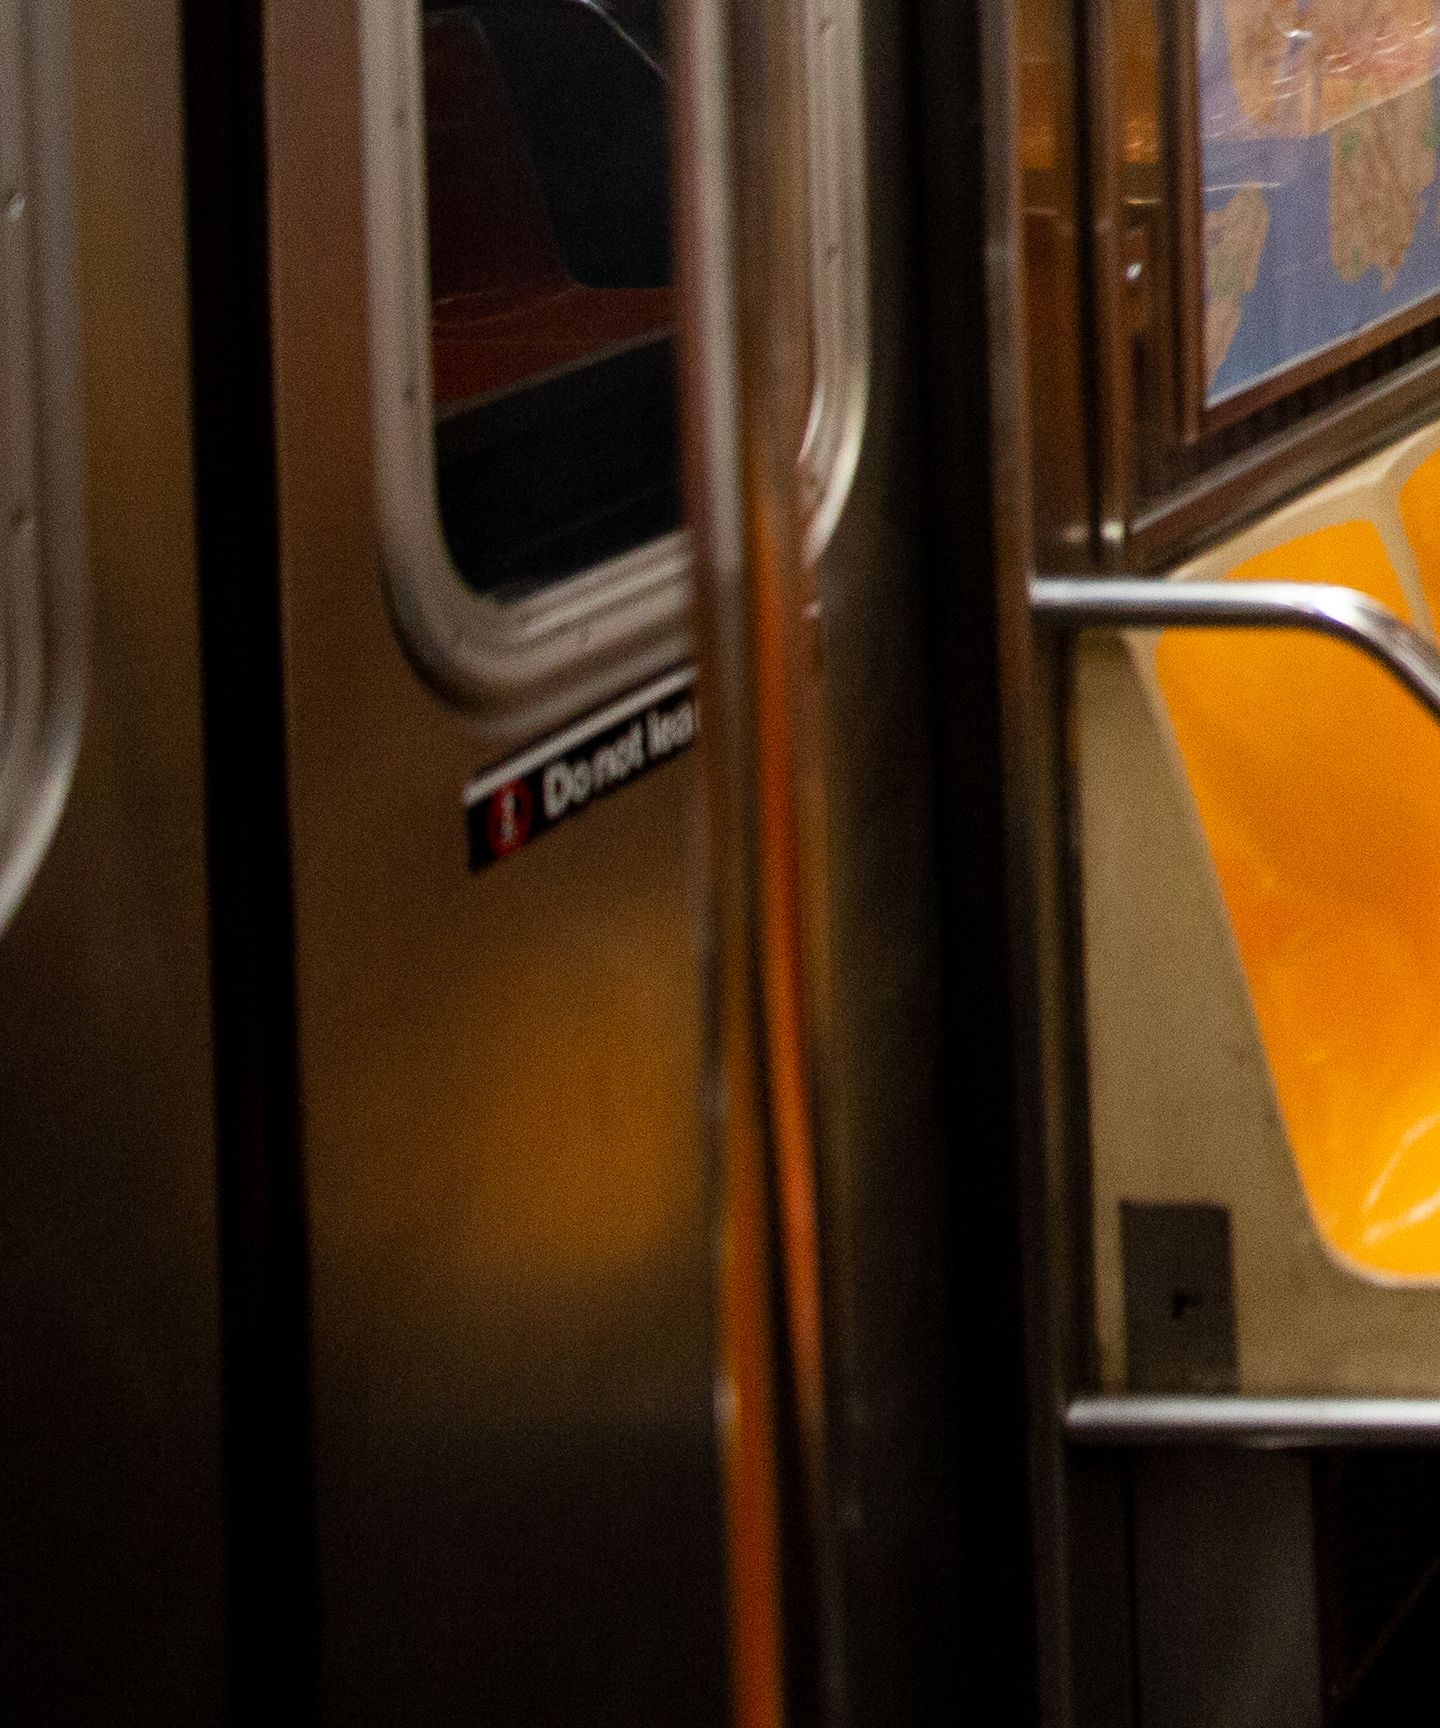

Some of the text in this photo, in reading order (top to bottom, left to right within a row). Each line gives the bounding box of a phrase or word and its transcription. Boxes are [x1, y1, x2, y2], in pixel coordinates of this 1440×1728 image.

[543, 700, 697, 820] Do not lea
